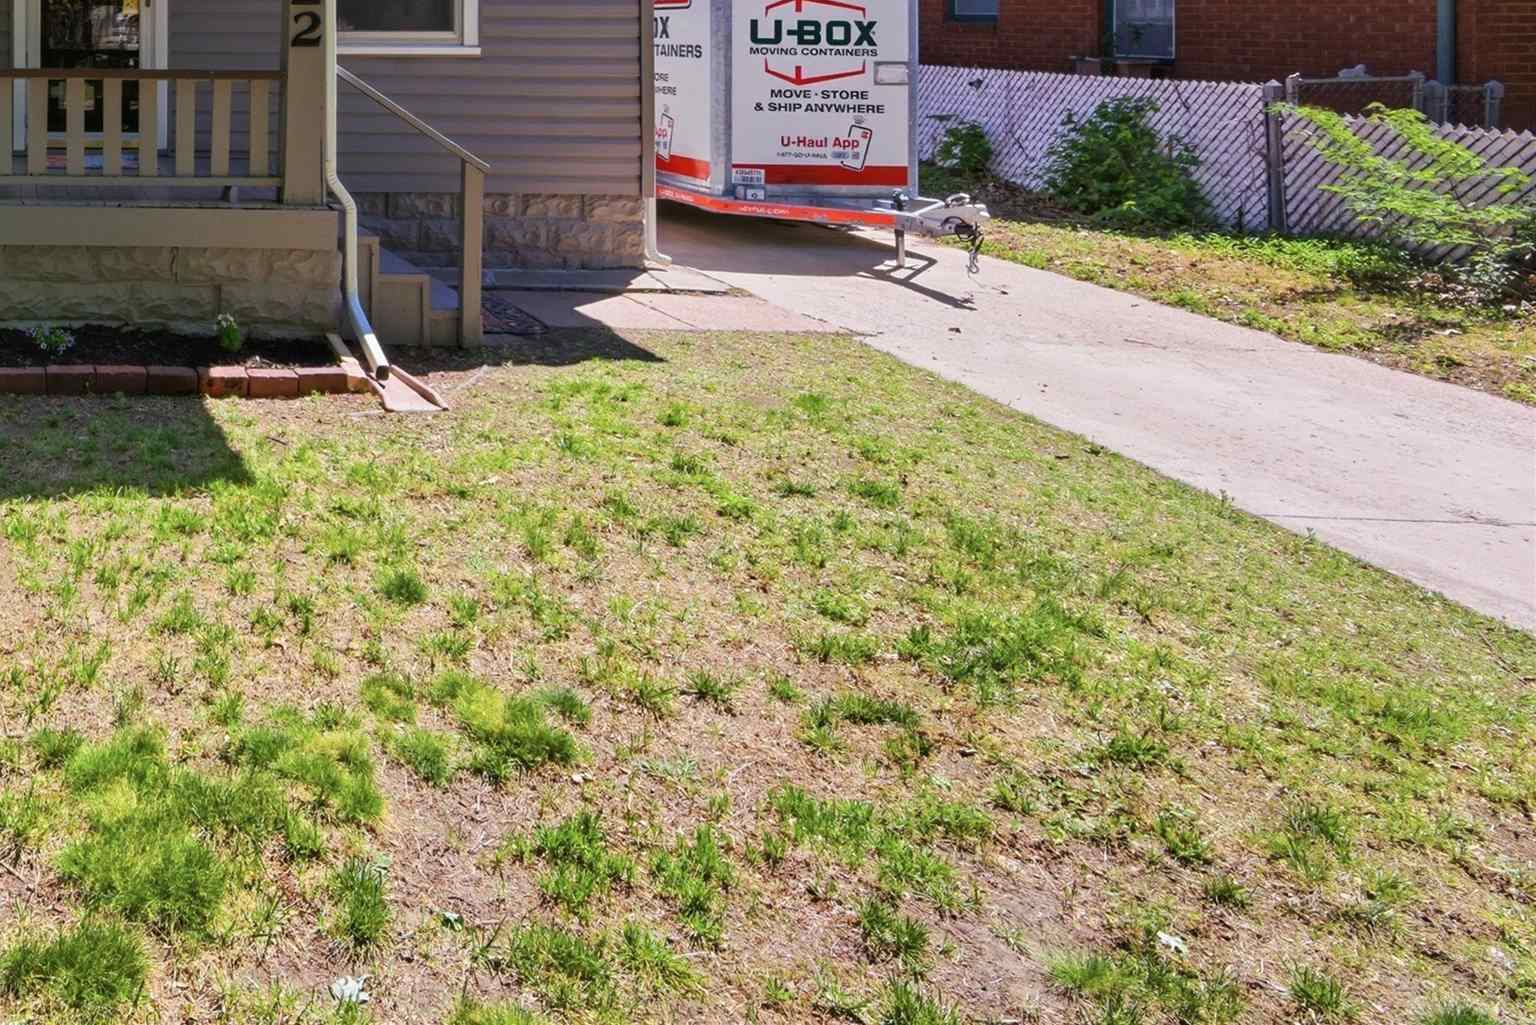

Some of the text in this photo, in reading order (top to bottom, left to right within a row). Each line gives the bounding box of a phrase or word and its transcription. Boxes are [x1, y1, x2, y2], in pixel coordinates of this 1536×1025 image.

[750, 19, 878, 47] U-BOX
[749, 47, 879, 57] MOVING CONTAINERS
[770, 89, 869, 100] MOVE STORE
[754, 102, 885, 114] & SHIP ANYWHERE
[780, 136, 860, 150] U-Haul App
